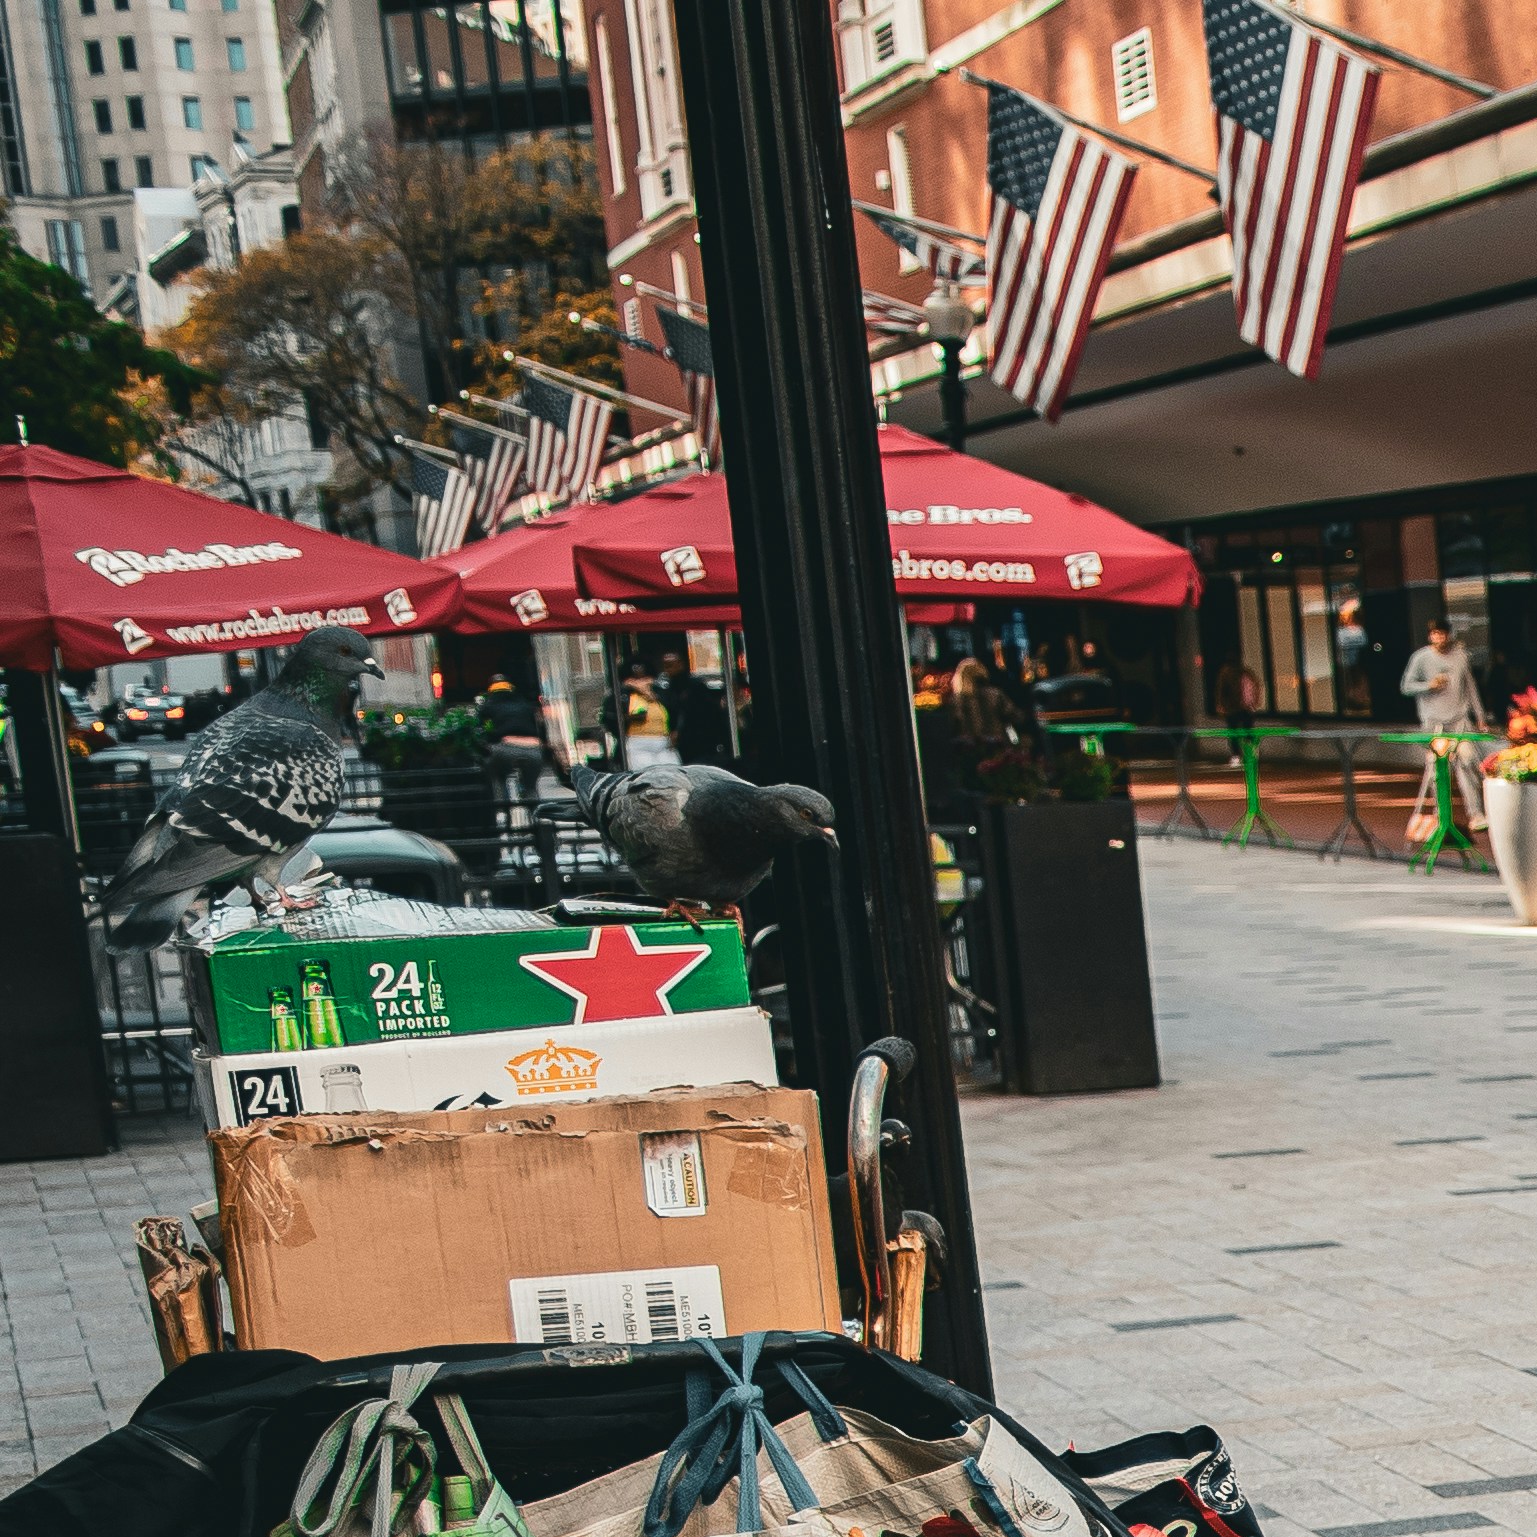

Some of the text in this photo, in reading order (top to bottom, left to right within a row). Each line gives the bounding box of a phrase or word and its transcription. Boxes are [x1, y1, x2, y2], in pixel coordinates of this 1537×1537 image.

[927, 505, 1033, 525] Bros.
[166, 605, 371, 645] www.rochebros.com
[369, 961, 424, 1000] 24
[431, 983, 442, 993] 12
[375, 999, 426, 1018] PACK
[378, 1015, 451, 1032] IMPORTED
[243, 1074, 289, 1115] 24
[684, 1161, 697, 1205] CAUTION
